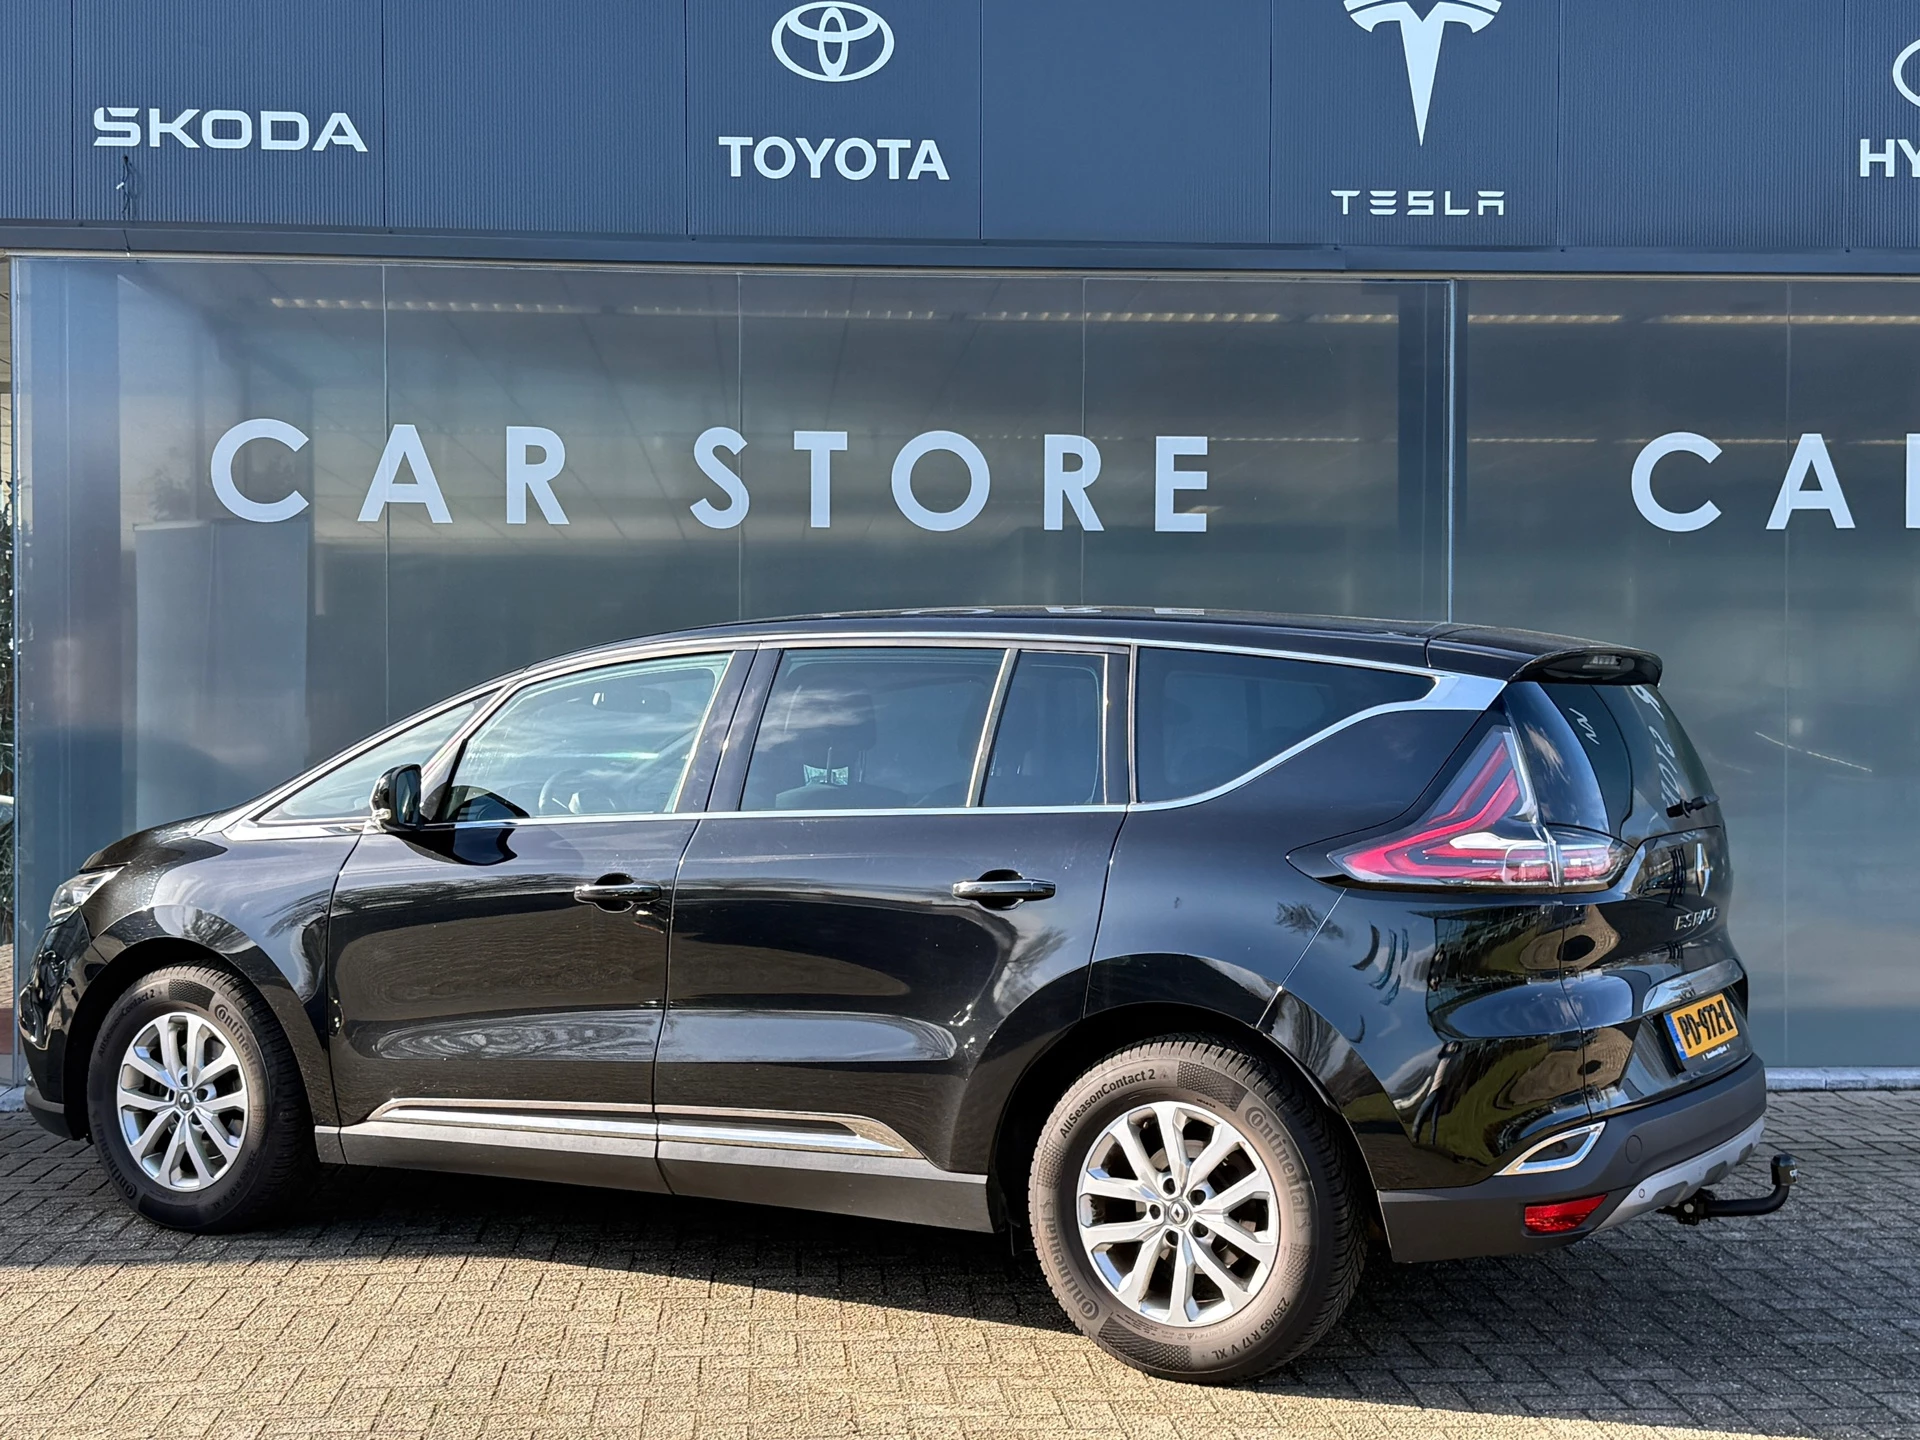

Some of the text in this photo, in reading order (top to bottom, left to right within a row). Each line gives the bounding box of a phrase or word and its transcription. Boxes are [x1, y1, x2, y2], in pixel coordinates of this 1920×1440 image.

[718, 136, 950, 181] TOYOTA
[1330, 190, 1505, 216] TESLA
[210, 418, 1208, 532] CAR STORE
[1677, 999, 1734, 1049] PD-972-K
[1060, 1069, 1156, 1139] AllSeasonContact 2
[1245, 1106, 1311, 1214] Continental
[1261, 1297, 1290, 1333] 235/65
[1211, 1348, 1228, 1360] XL
